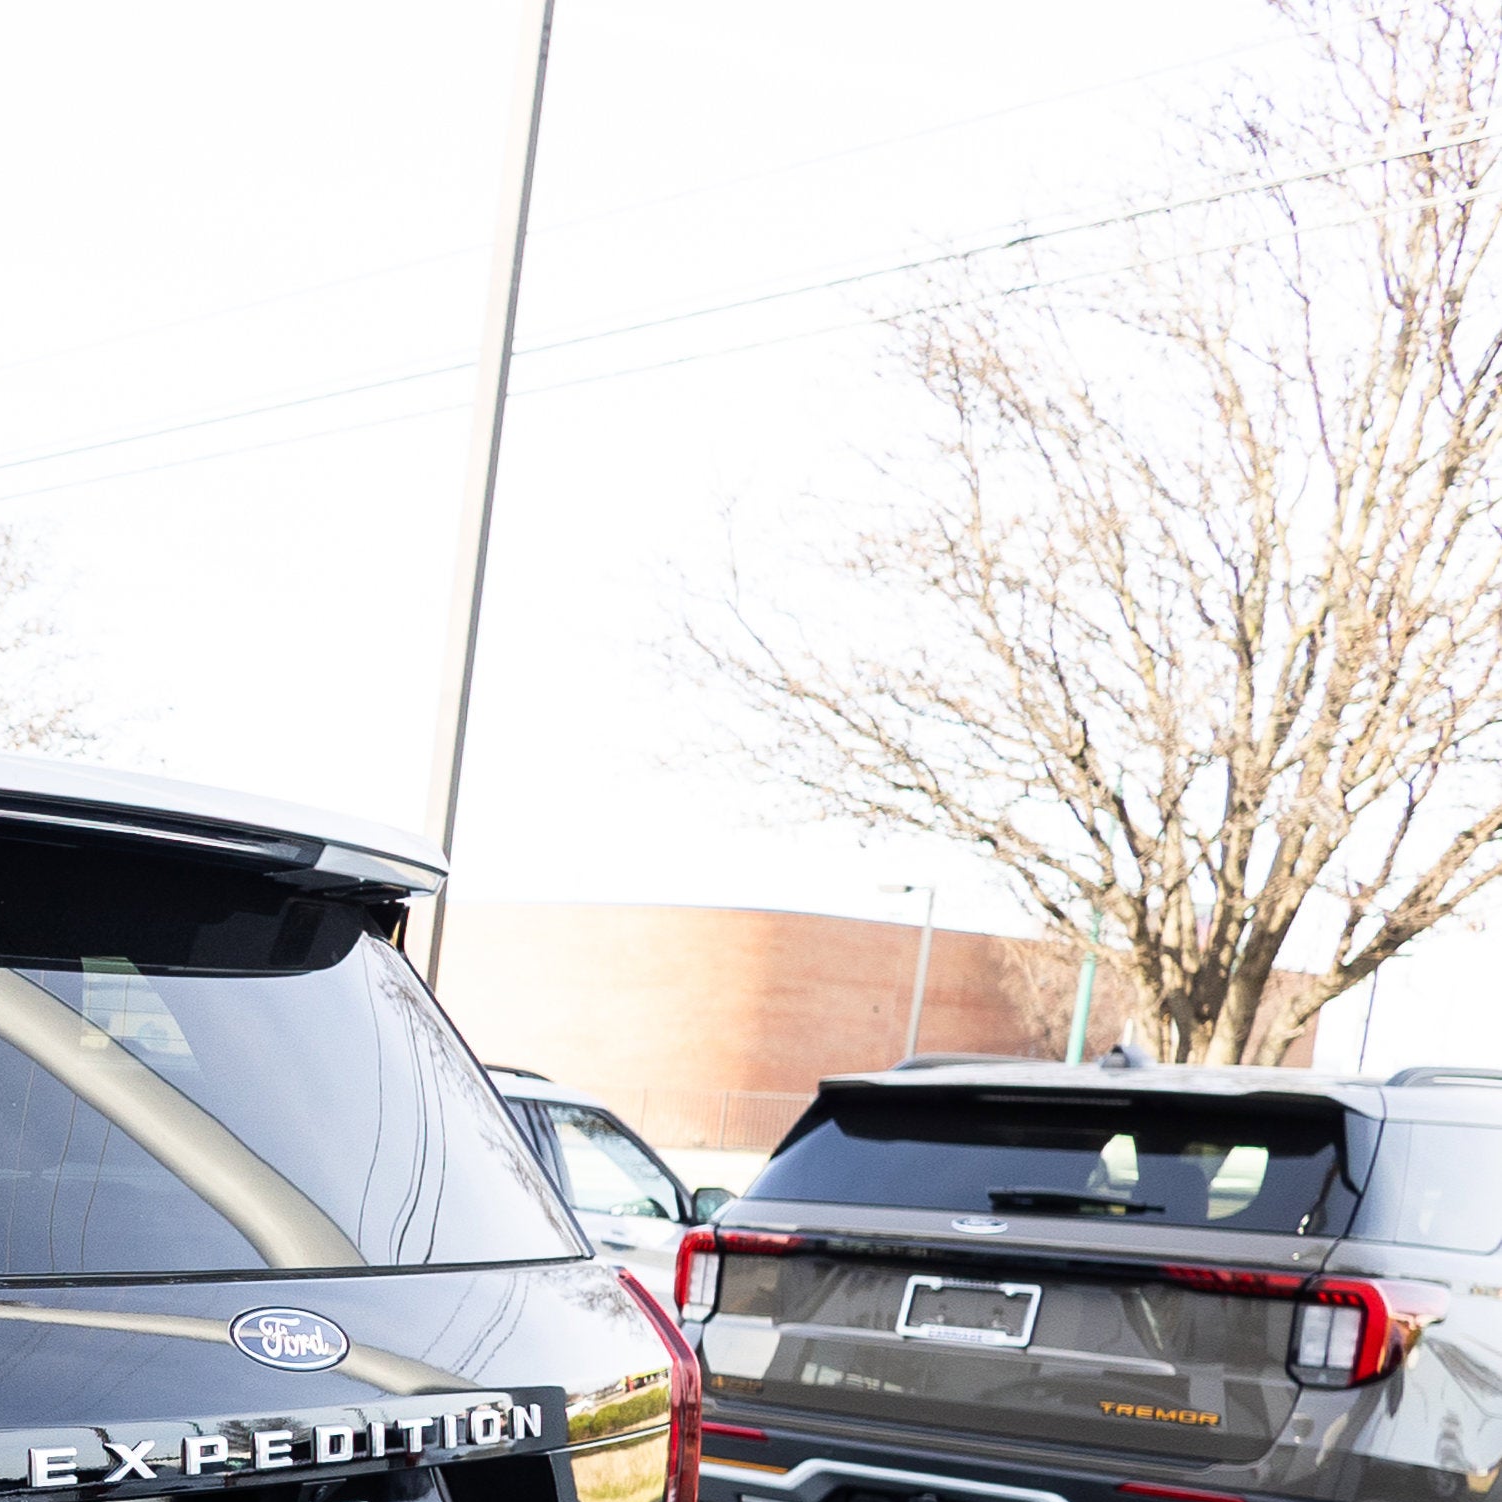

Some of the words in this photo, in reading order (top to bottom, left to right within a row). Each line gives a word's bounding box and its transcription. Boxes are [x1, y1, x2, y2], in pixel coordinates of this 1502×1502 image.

[259, 1317, 330, 1359] Ford
[1099, 1400, 1220, 1427] TREMOR
[27, 1402, 543, 1488] EXPEDITION
